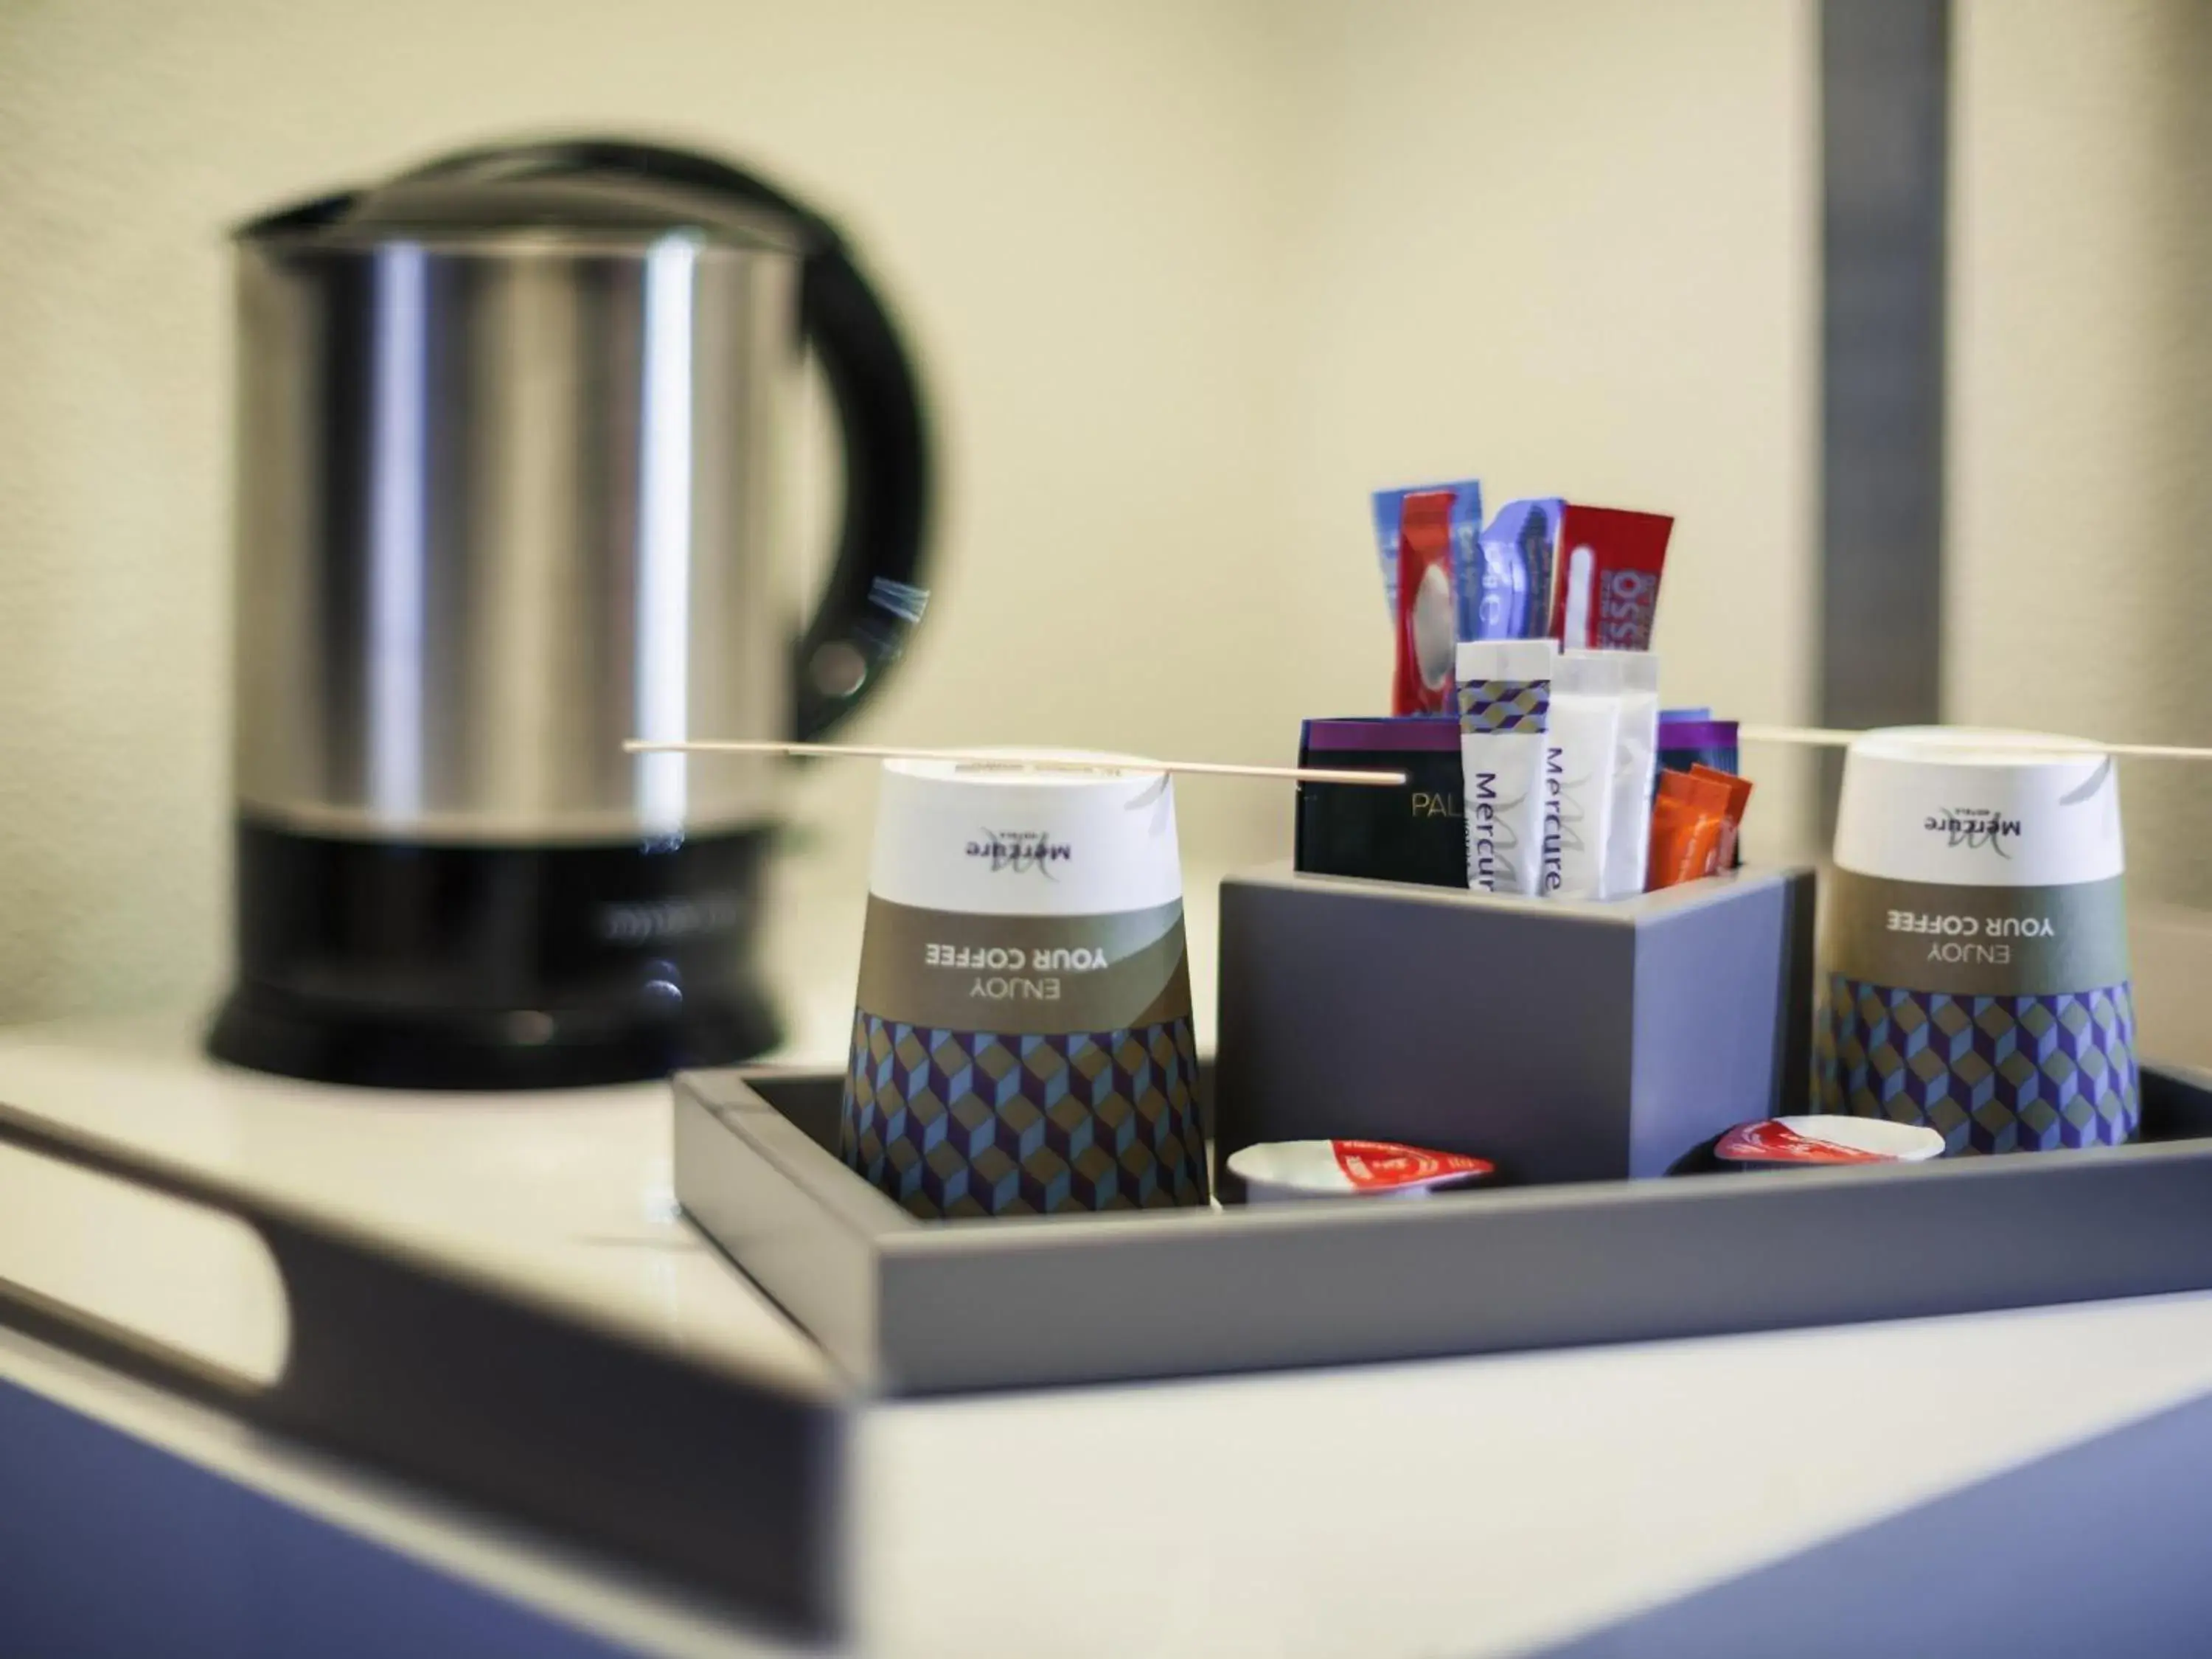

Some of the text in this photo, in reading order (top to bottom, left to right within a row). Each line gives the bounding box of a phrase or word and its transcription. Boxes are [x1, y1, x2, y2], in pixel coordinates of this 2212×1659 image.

[1411, 792, 1463, 818] PAL
[1544, 747, 1563, 891] Mercure
[1924, 816, 2021, 837] Mercure
[965, 841, 1071, 861] Mercure
[1885, 908, 2055, 937] YOUR COFFEE
[925, 943, 1109, 971] YOUR COFFEE
[1927, 942, 2011, 964] ENJOY
[970, 977, 1061, 1001] ENJOY
